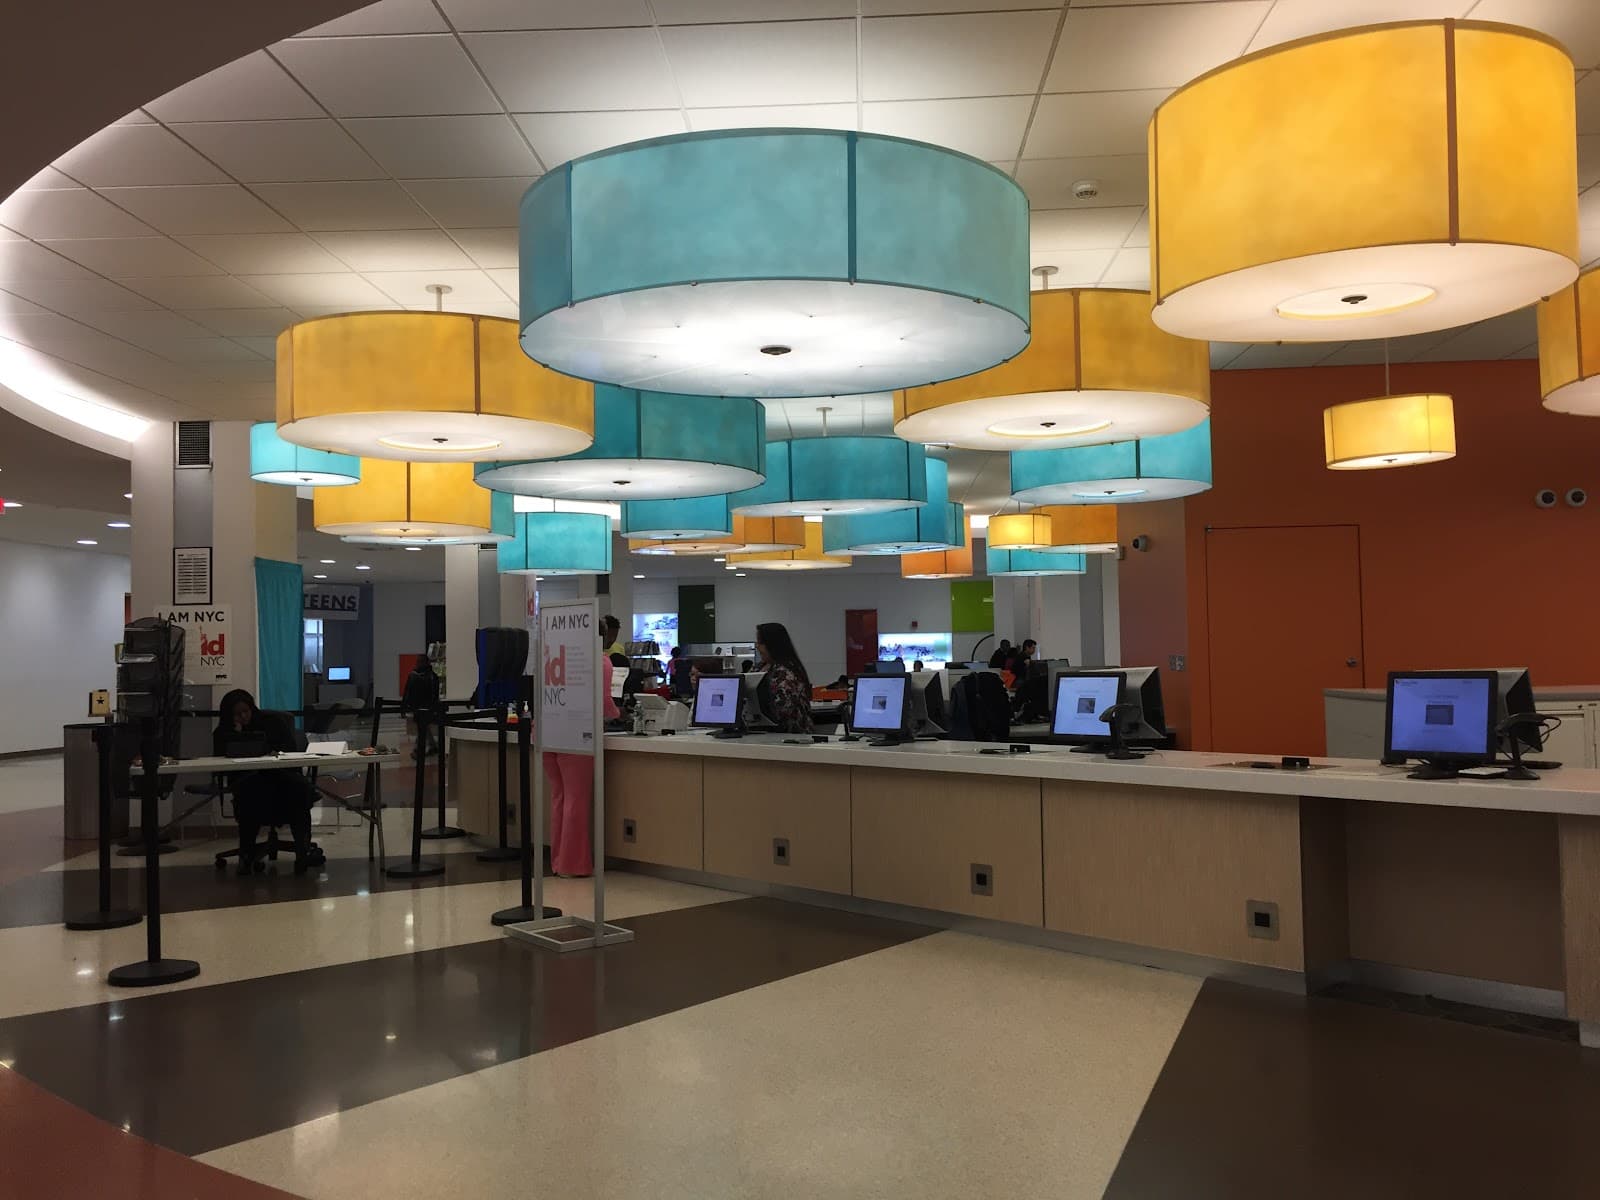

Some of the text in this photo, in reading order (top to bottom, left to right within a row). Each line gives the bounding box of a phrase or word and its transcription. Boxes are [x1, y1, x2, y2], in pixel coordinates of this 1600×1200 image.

[167, 611, 189, 622] AM
[194, 611, 225, 622] NYC
[545, 615, 549, 631] I
[551, 615, 566, 631] AM
[568, 614, 590, 630] NYC
[200, 655, 225, 667] NYC
[544, 644, 566, 687] id
[544, 687, 566, 706] NYC
